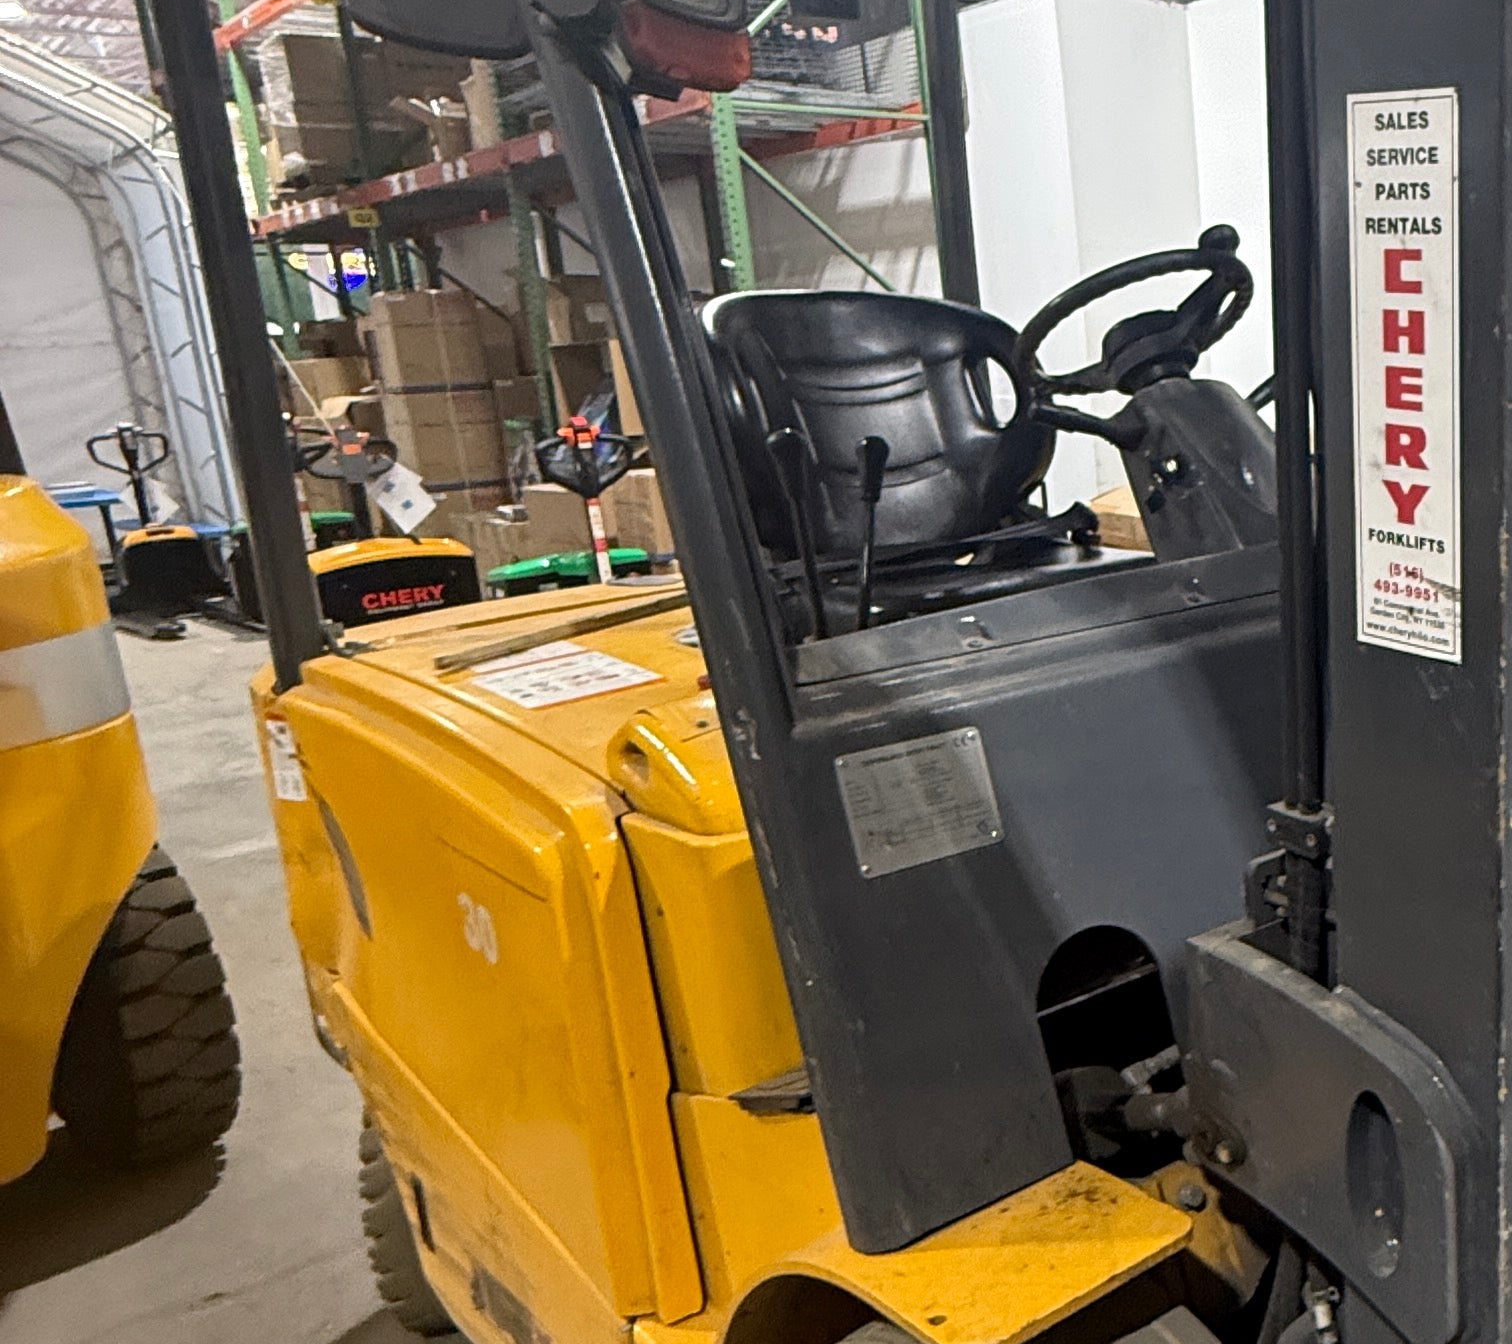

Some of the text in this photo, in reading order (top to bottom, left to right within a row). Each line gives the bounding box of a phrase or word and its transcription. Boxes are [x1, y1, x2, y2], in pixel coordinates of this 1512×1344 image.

[1374, 111, 1429, 131] SALES
[1366, 146, 1439, 166] SERVICE
[1375, 181, 1431, 201] PARTS
[1365, 216, 1442, 235] RENTALS
[1382, 248, 1431, 525] CHERY
[1368, 528, 1445, 553] FORKLIFTS
[361, 584, 444, 610] CHERY
